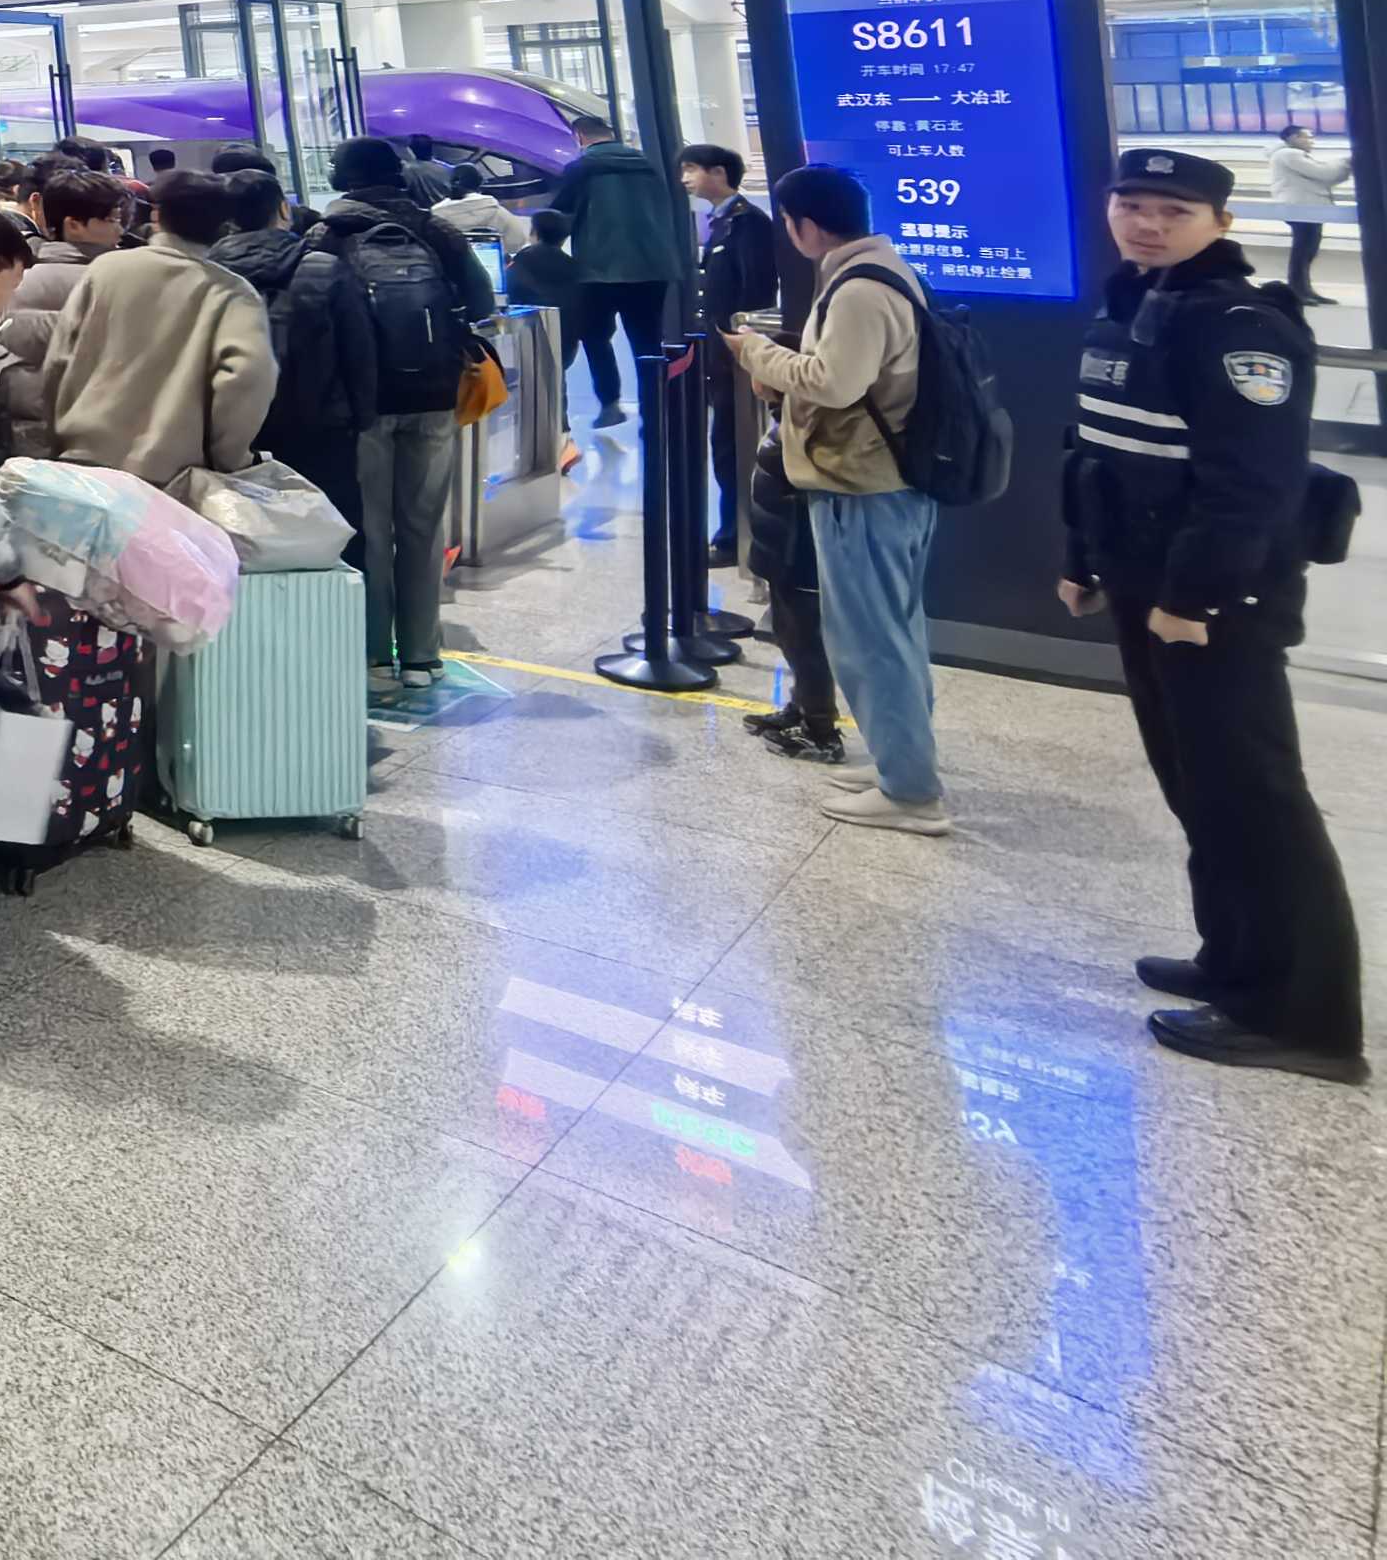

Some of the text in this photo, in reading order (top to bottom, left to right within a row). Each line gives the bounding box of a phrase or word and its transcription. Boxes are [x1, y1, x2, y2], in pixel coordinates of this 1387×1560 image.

[852, 17, 973, 51] S8611
[860, 63, 975, 77] 开车时间 17:47
[837, 89, 1011, 107] 武汉东 大冶北
[887, 144, 965, 158] 可上车人数
[896, 178, 961, 206] 539
[900, 222, 969, 239] 温馨提示
